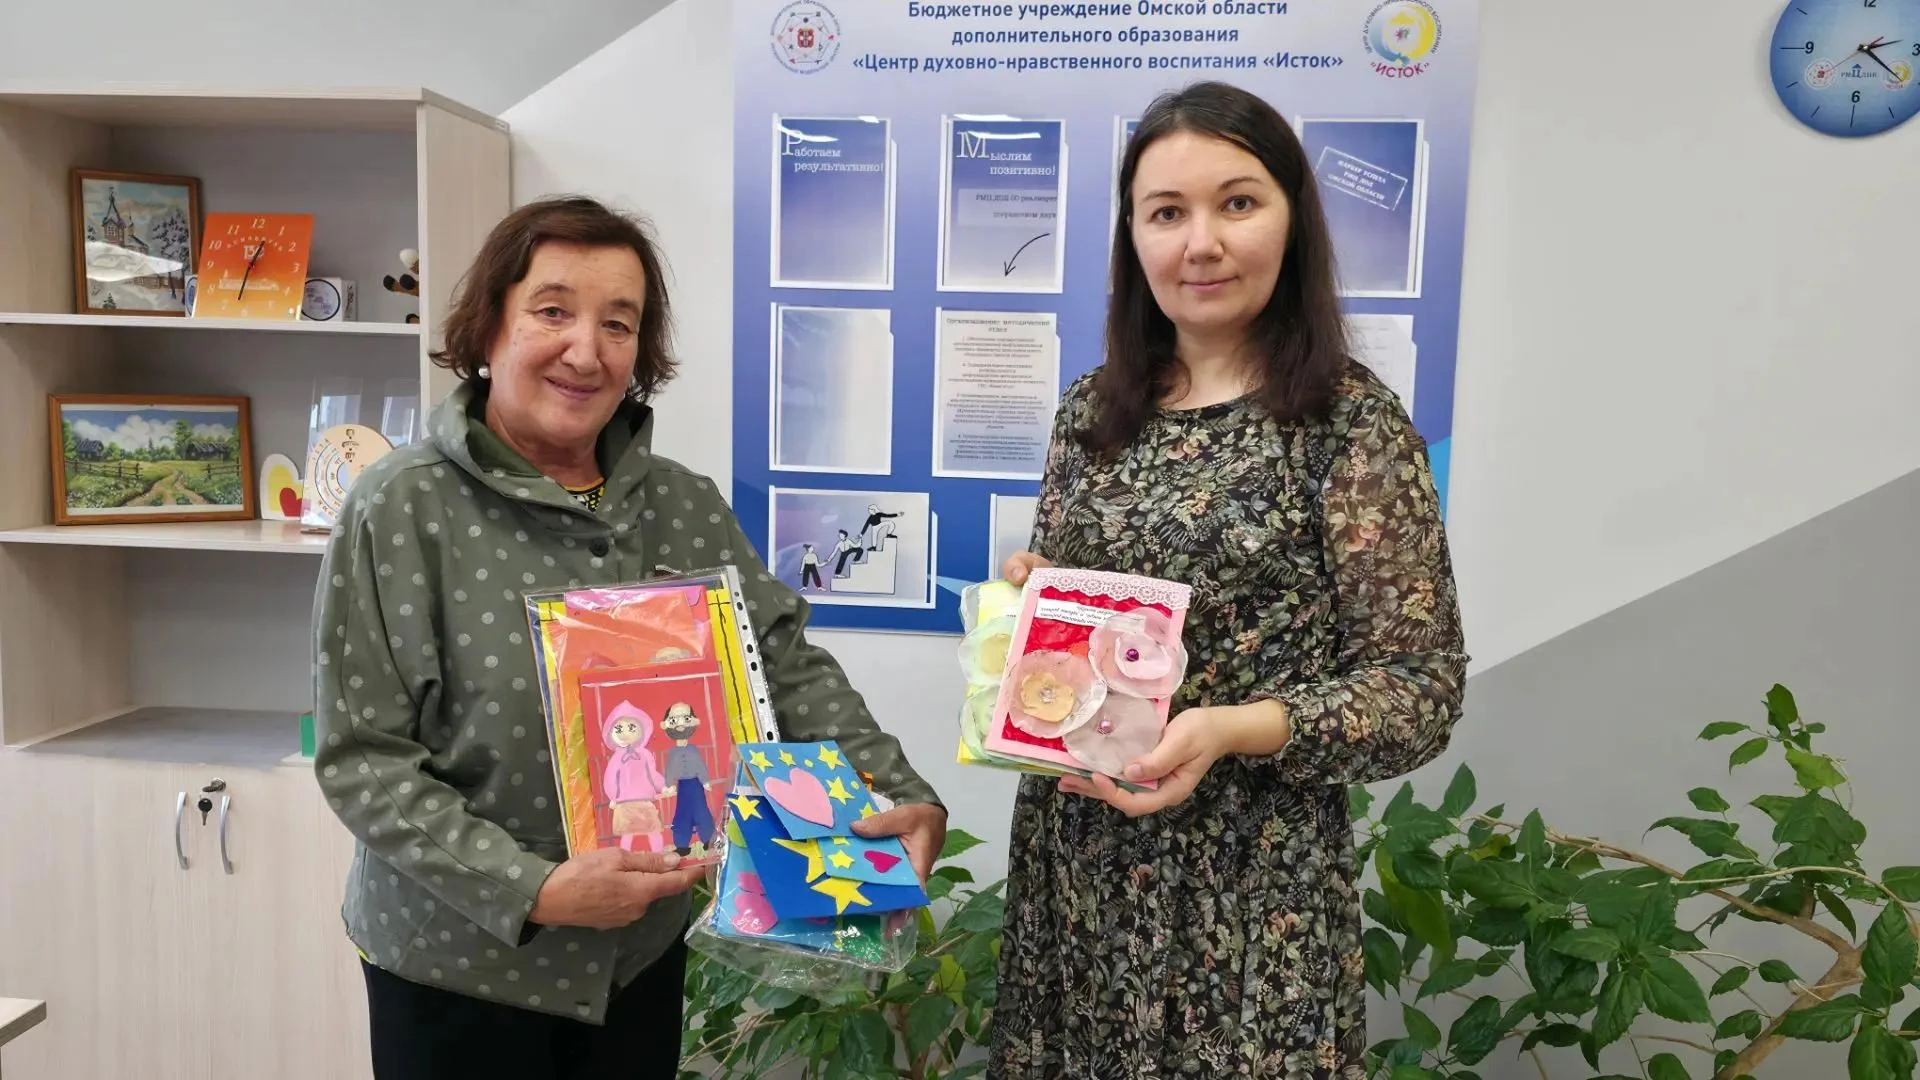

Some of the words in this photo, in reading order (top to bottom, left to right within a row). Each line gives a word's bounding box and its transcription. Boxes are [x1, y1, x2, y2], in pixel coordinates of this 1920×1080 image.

[908, 1, 1014, 19] Бюджетное
[1018, 1, 1132, 20] учреждение
[1137, 0, 1207, 16] Омской
[1212, 0, 1288, 15] области
[951, 30, 1113, 46] дополнительного
[1117, 26, 1239, 46] образования
[1804, 41, 1814, 54] 9
[852, 54, 919, 73] «Центр
[922, 55, 1143, 73] духовно-нравственного
[1147, 54, 1258, 70] воспитания
[1262, 52, 1344, 69] «Исток»
[1851, 91, 1861, 103] 6
[782, 129, 841, 157] Работаем
[956, 131, 1033, 161] Мыслим
[794, 160, 884, 172] результативно!
[990, 165, 1056, 176] позитивно!
[253, 218, 266, 229] 12
[227, 224, 240, 235] 11
[279, 225, 285, 236] 1
[208, 239, 222, 250] 10
[288, 241, 297, 252] 2
[207, 260, 215, 270] 9
[292, 262, 300, 273] 3
